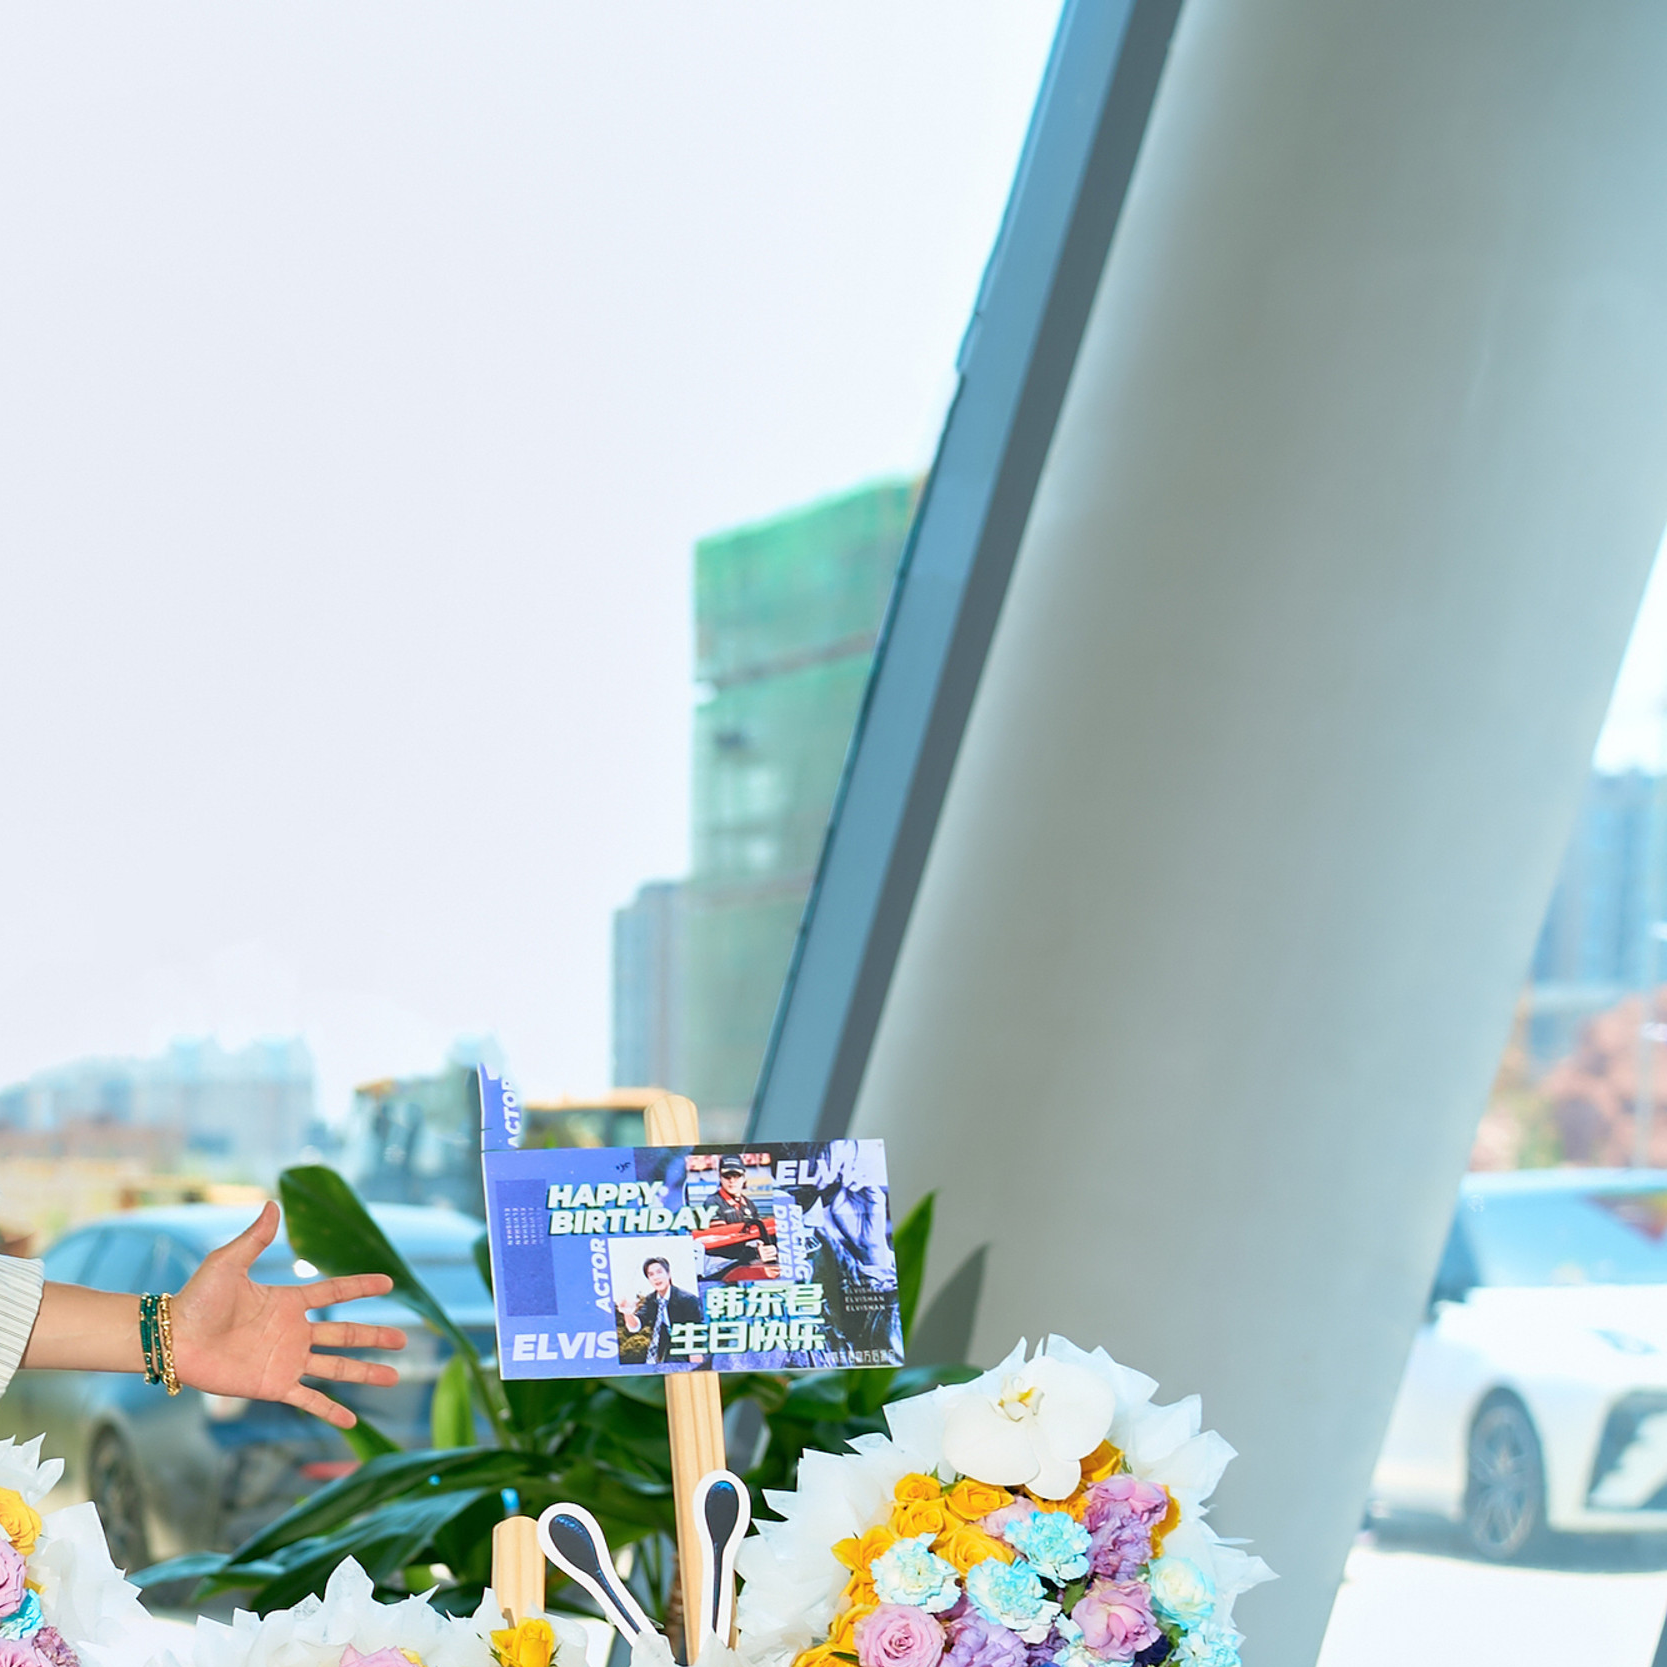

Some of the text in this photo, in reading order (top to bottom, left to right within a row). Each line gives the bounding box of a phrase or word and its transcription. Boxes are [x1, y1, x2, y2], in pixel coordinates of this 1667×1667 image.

[547, 1181, 664, 1209] HAPPY
[549, 1205, 718, 1236] BIRTHDAY
[772, 1204, 794, 1279] DRIVER
[788, 1204, 810, 1281] RACING
[587, 1237, 612, 1313] ACTOR
[706, 1283, 825, 1320] 韩东君
[512, 1331, 618, 1362] ELVIS
[670, 1318, 825, 1355] 生日快乐
